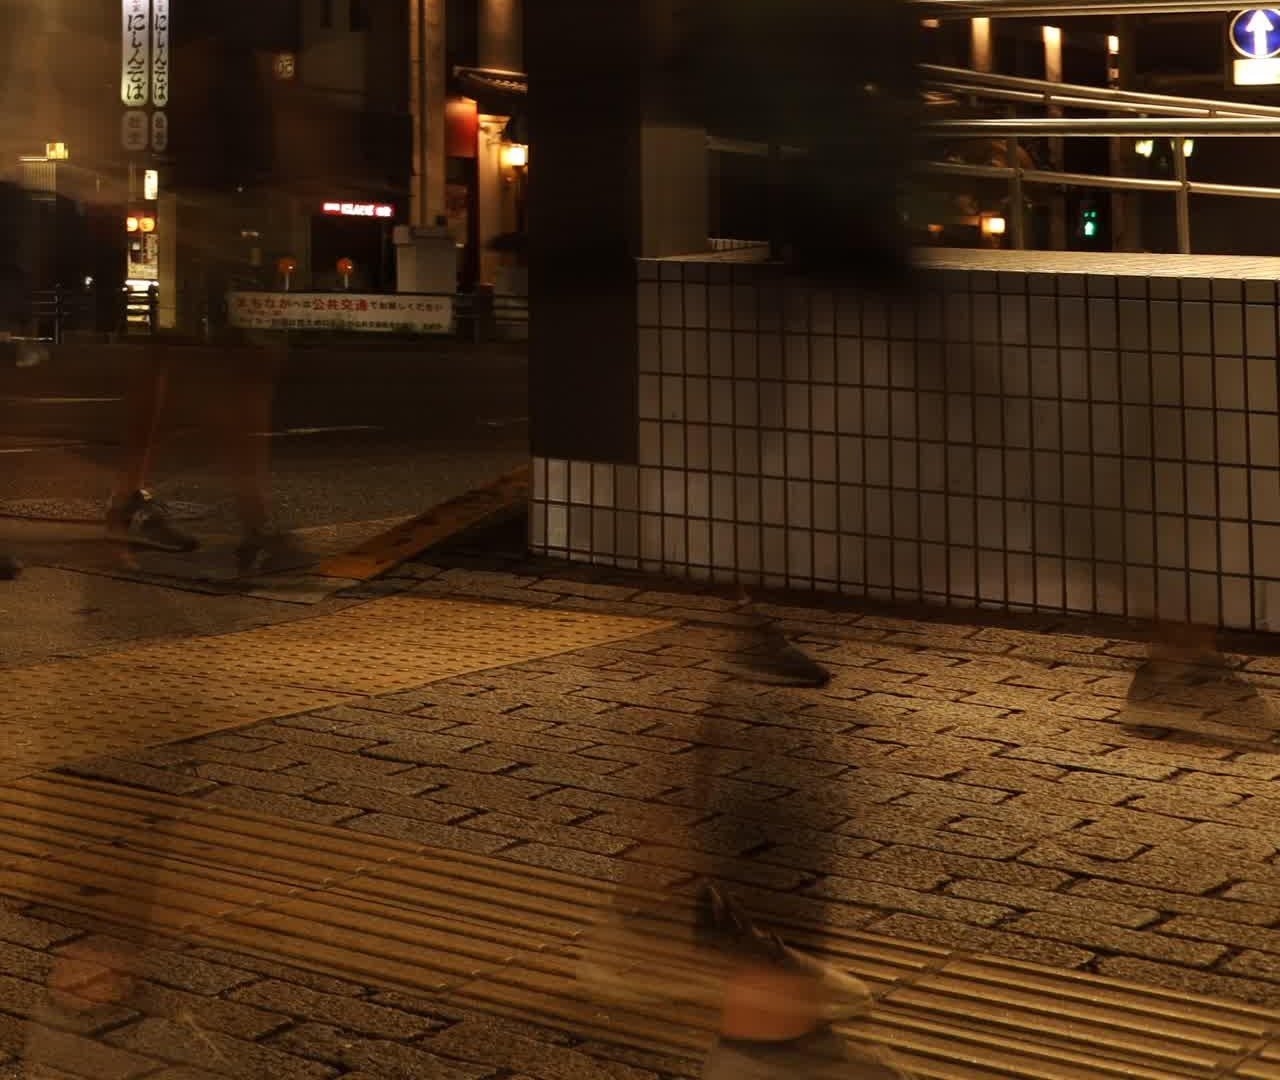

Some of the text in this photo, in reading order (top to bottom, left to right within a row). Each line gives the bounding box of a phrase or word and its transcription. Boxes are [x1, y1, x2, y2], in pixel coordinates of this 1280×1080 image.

[127, 15, 145, 99] にしんそば
[155, 15, 167, 99] にしんそば
